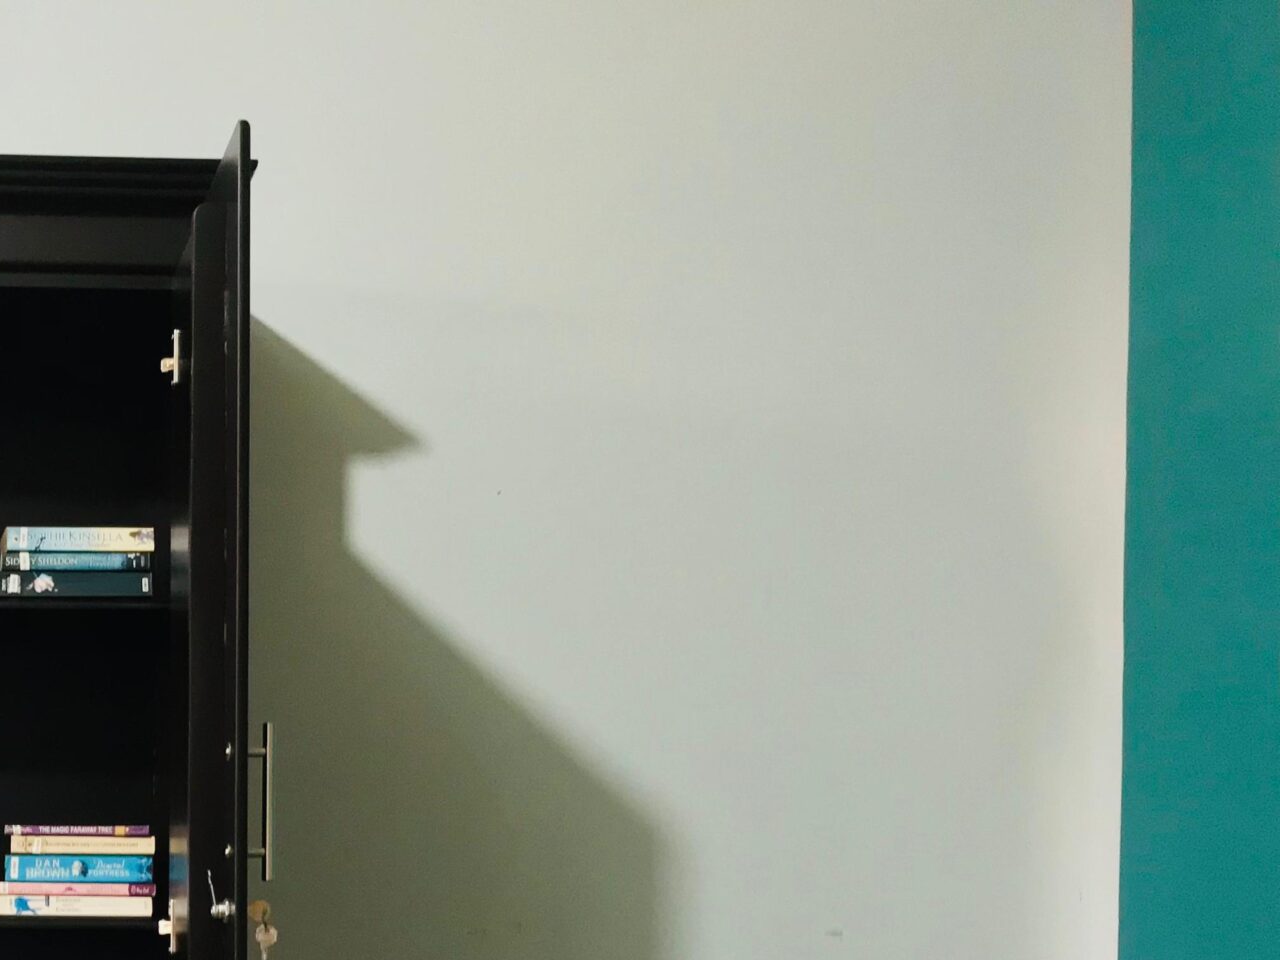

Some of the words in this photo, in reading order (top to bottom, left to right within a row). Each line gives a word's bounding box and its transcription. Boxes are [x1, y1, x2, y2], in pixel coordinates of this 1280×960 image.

[68, 531, 123, 541] KINSELLA
[5, 557, 35, 566] SIDY
[38, 557, 78, 566] SHELDON
[35, 859, 60, 867] DAN
[26, 868, 70, 879] BROWN
